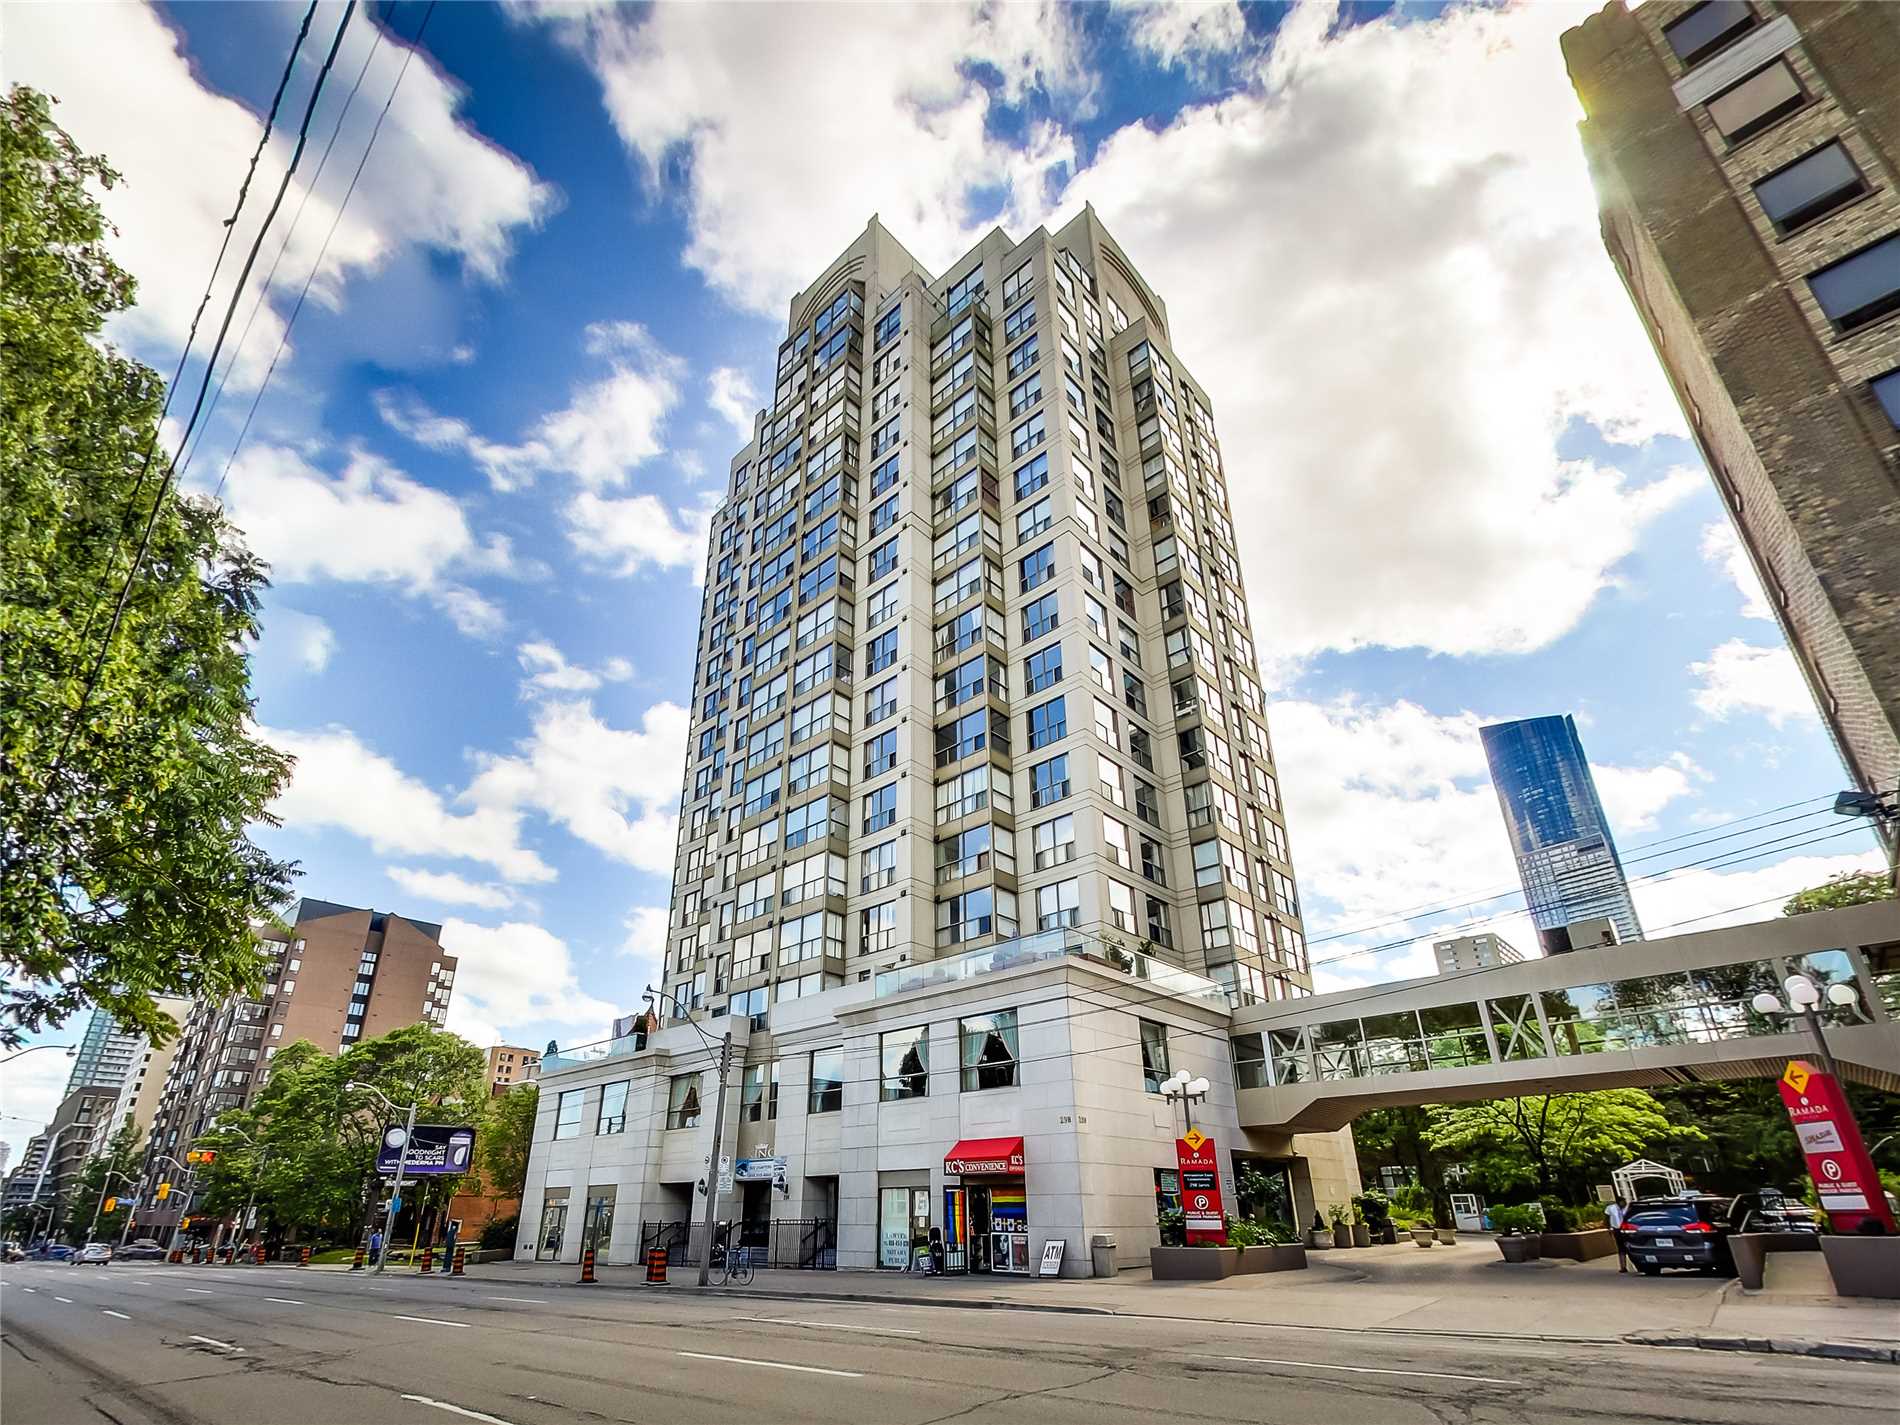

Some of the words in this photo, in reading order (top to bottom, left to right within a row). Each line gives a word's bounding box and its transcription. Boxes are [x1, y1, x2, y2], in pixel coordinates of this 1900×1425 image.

[1788, 1105, 1829, 1117] RAMADA
[1011, 1154, 1023, 1165] KC'S
[945, 1159, 965, 1174] KC'S
[965, 1162, 1006, 1172] CONVENIENCE
[1043, 1245, 1062, 1260] ATM
